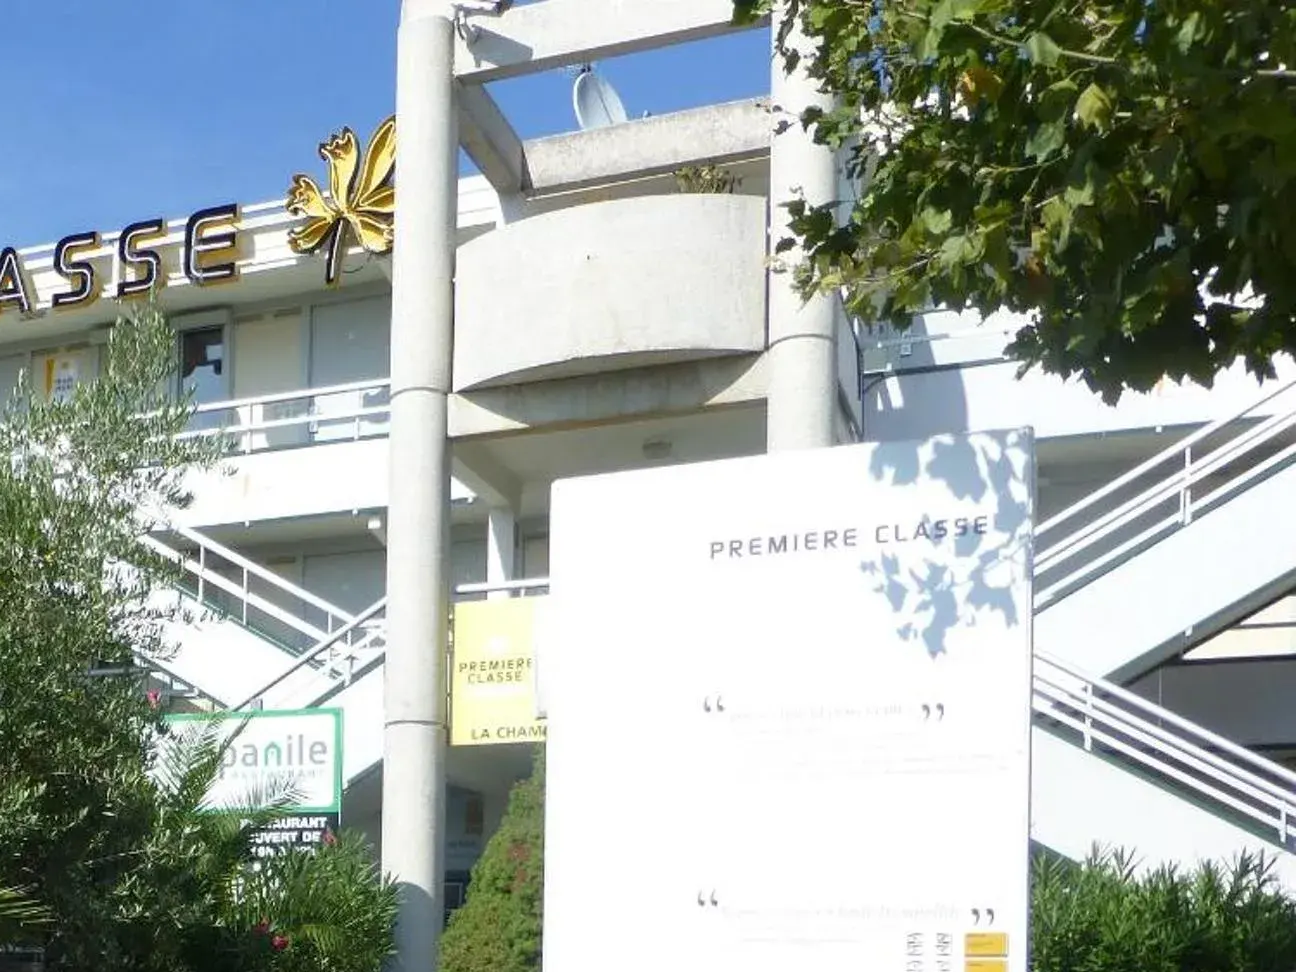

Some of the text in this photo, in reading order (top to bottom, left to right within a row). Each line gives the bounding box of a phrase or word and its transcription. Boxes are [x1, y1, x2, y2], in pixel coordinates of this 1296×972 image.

[709, 514, 989, 560] PREMIERE CLASSE
[467, 670, 523, 684] CLASSE
[471, 727, 490, 740] LA
[302, 830, 321, 842] DE
